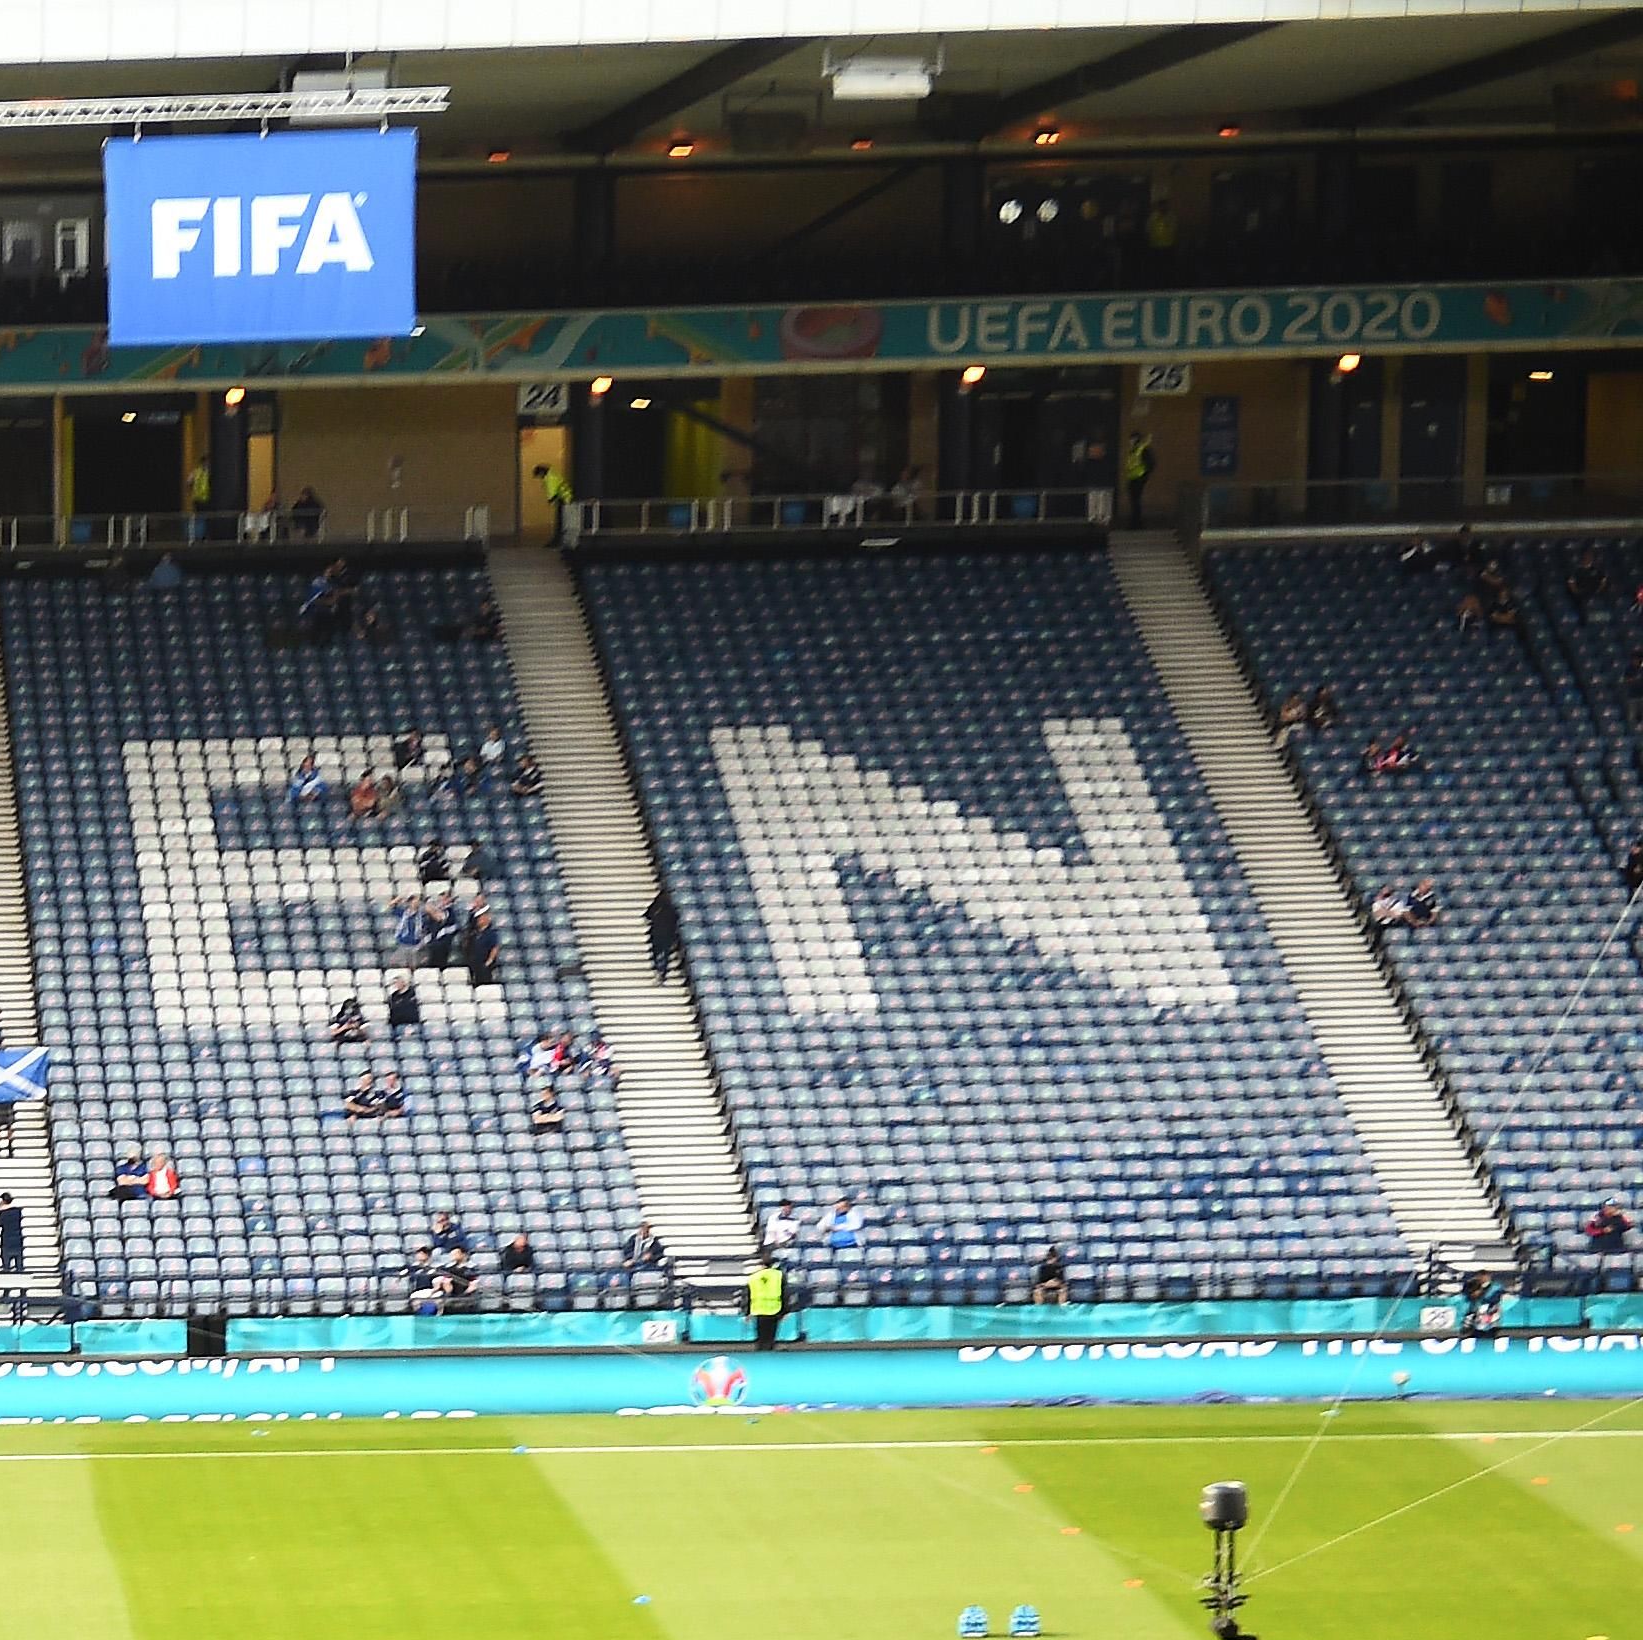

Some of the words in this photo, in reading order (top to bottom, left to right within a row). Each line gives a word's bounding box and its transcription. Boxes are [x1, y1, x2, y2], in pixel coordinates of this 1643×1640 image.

[151, 192, 374, 279] FIFA
[928, 303, 1089, 353] UEFA
[1103, 297, 1272, 348] EURO
[1284, 291, 1441, 343] 2020
